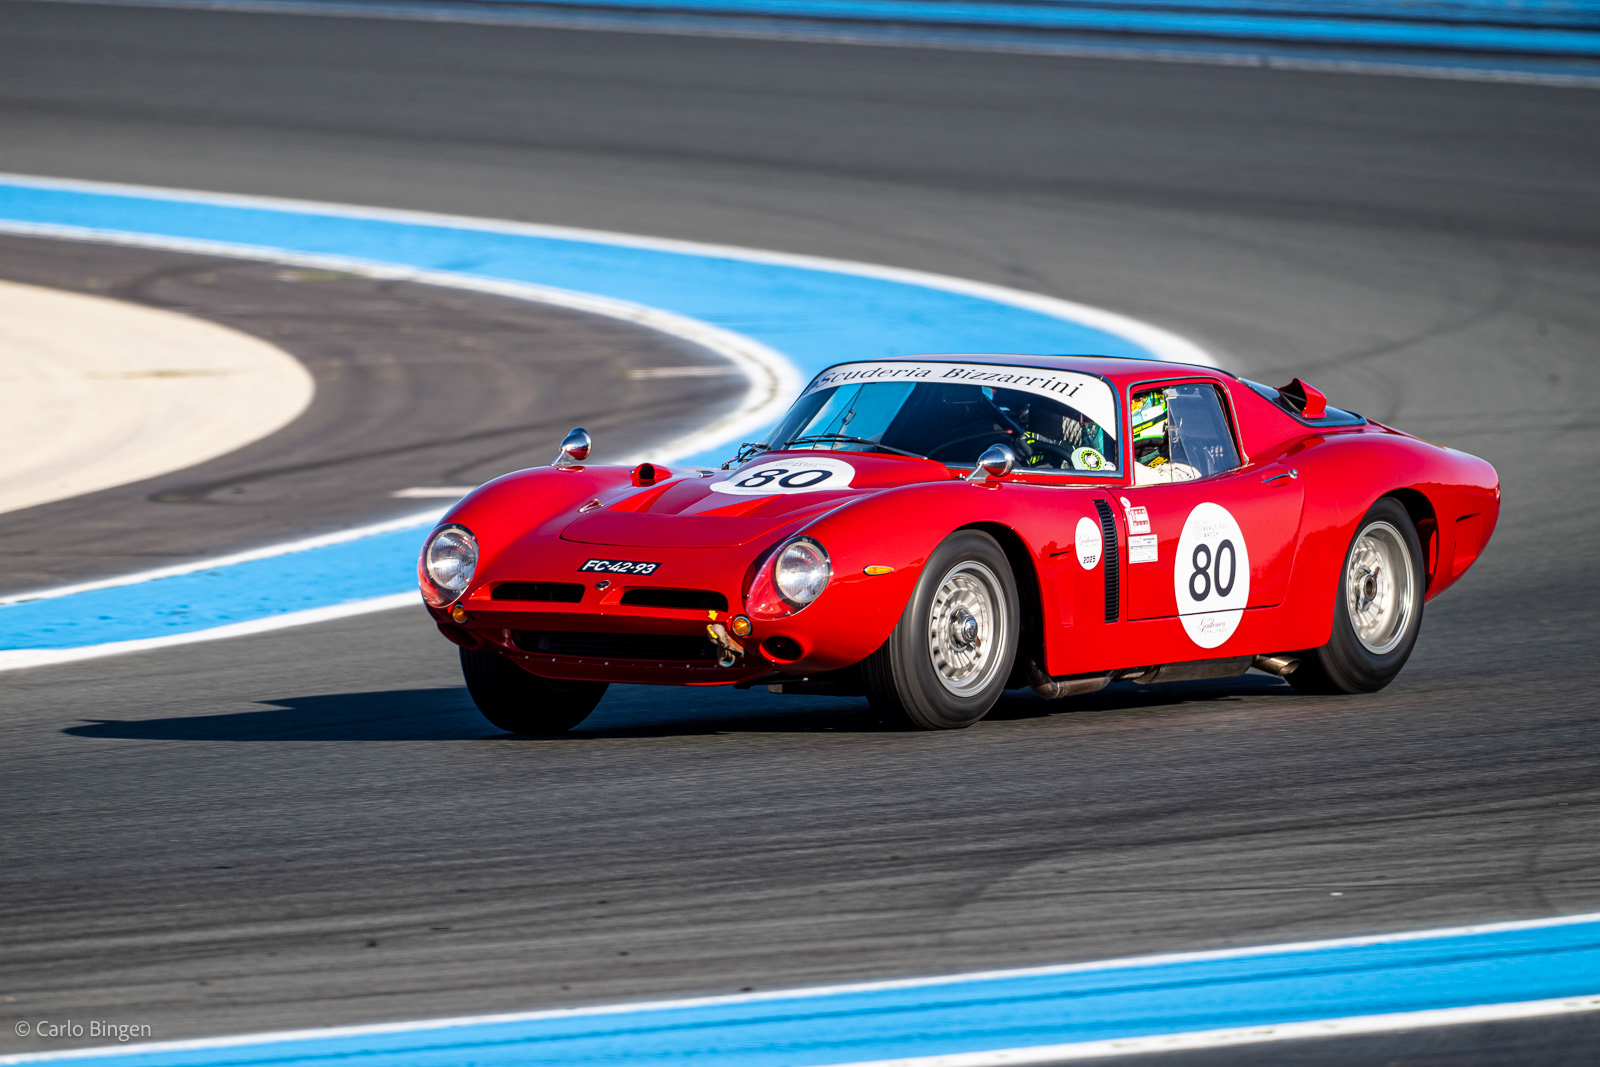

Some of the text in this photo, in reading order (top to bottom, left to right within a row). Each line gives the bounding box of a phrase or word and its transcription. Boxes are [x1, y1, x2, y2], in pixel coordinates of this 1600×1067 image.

[816, 367, 1083, 399] Scuderia Bizzarrini
[734, 468, 834, 489] 80
[582, 560, 656, 574] FC-42-93
[1083, 555, 1096, 564] 2025
[1189, 539, 1236, 602] 80
